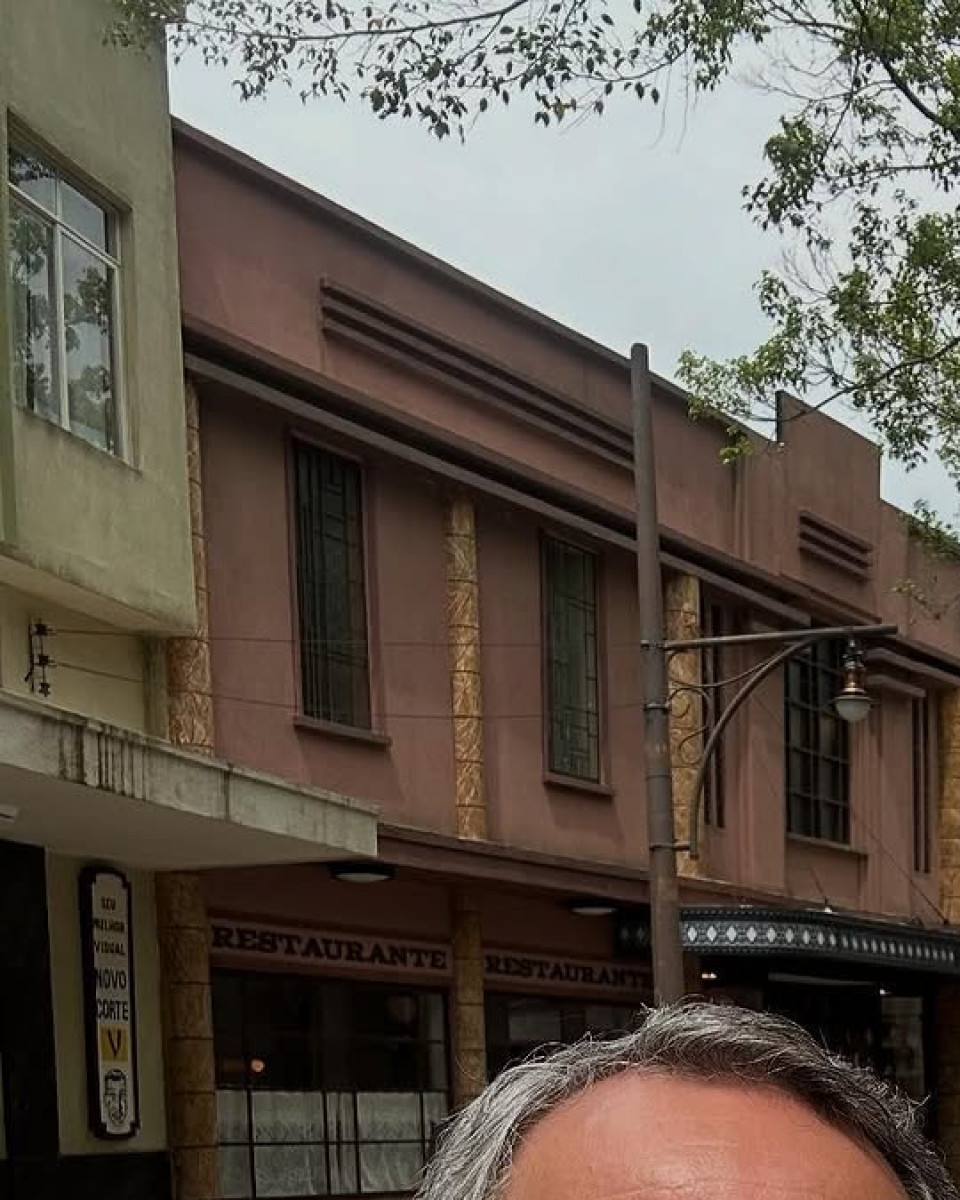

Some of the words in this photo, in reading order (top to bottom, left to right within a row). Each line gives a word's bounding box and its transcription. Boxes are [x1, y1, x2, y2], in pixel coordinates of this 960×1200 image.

[94, 940, 126, 956] VISUAL
[211, 925, 448, 970] RESTAURANTE
[95, 967, 127, 990] NOVO
[96, 999, 129, 1021] CORTE
